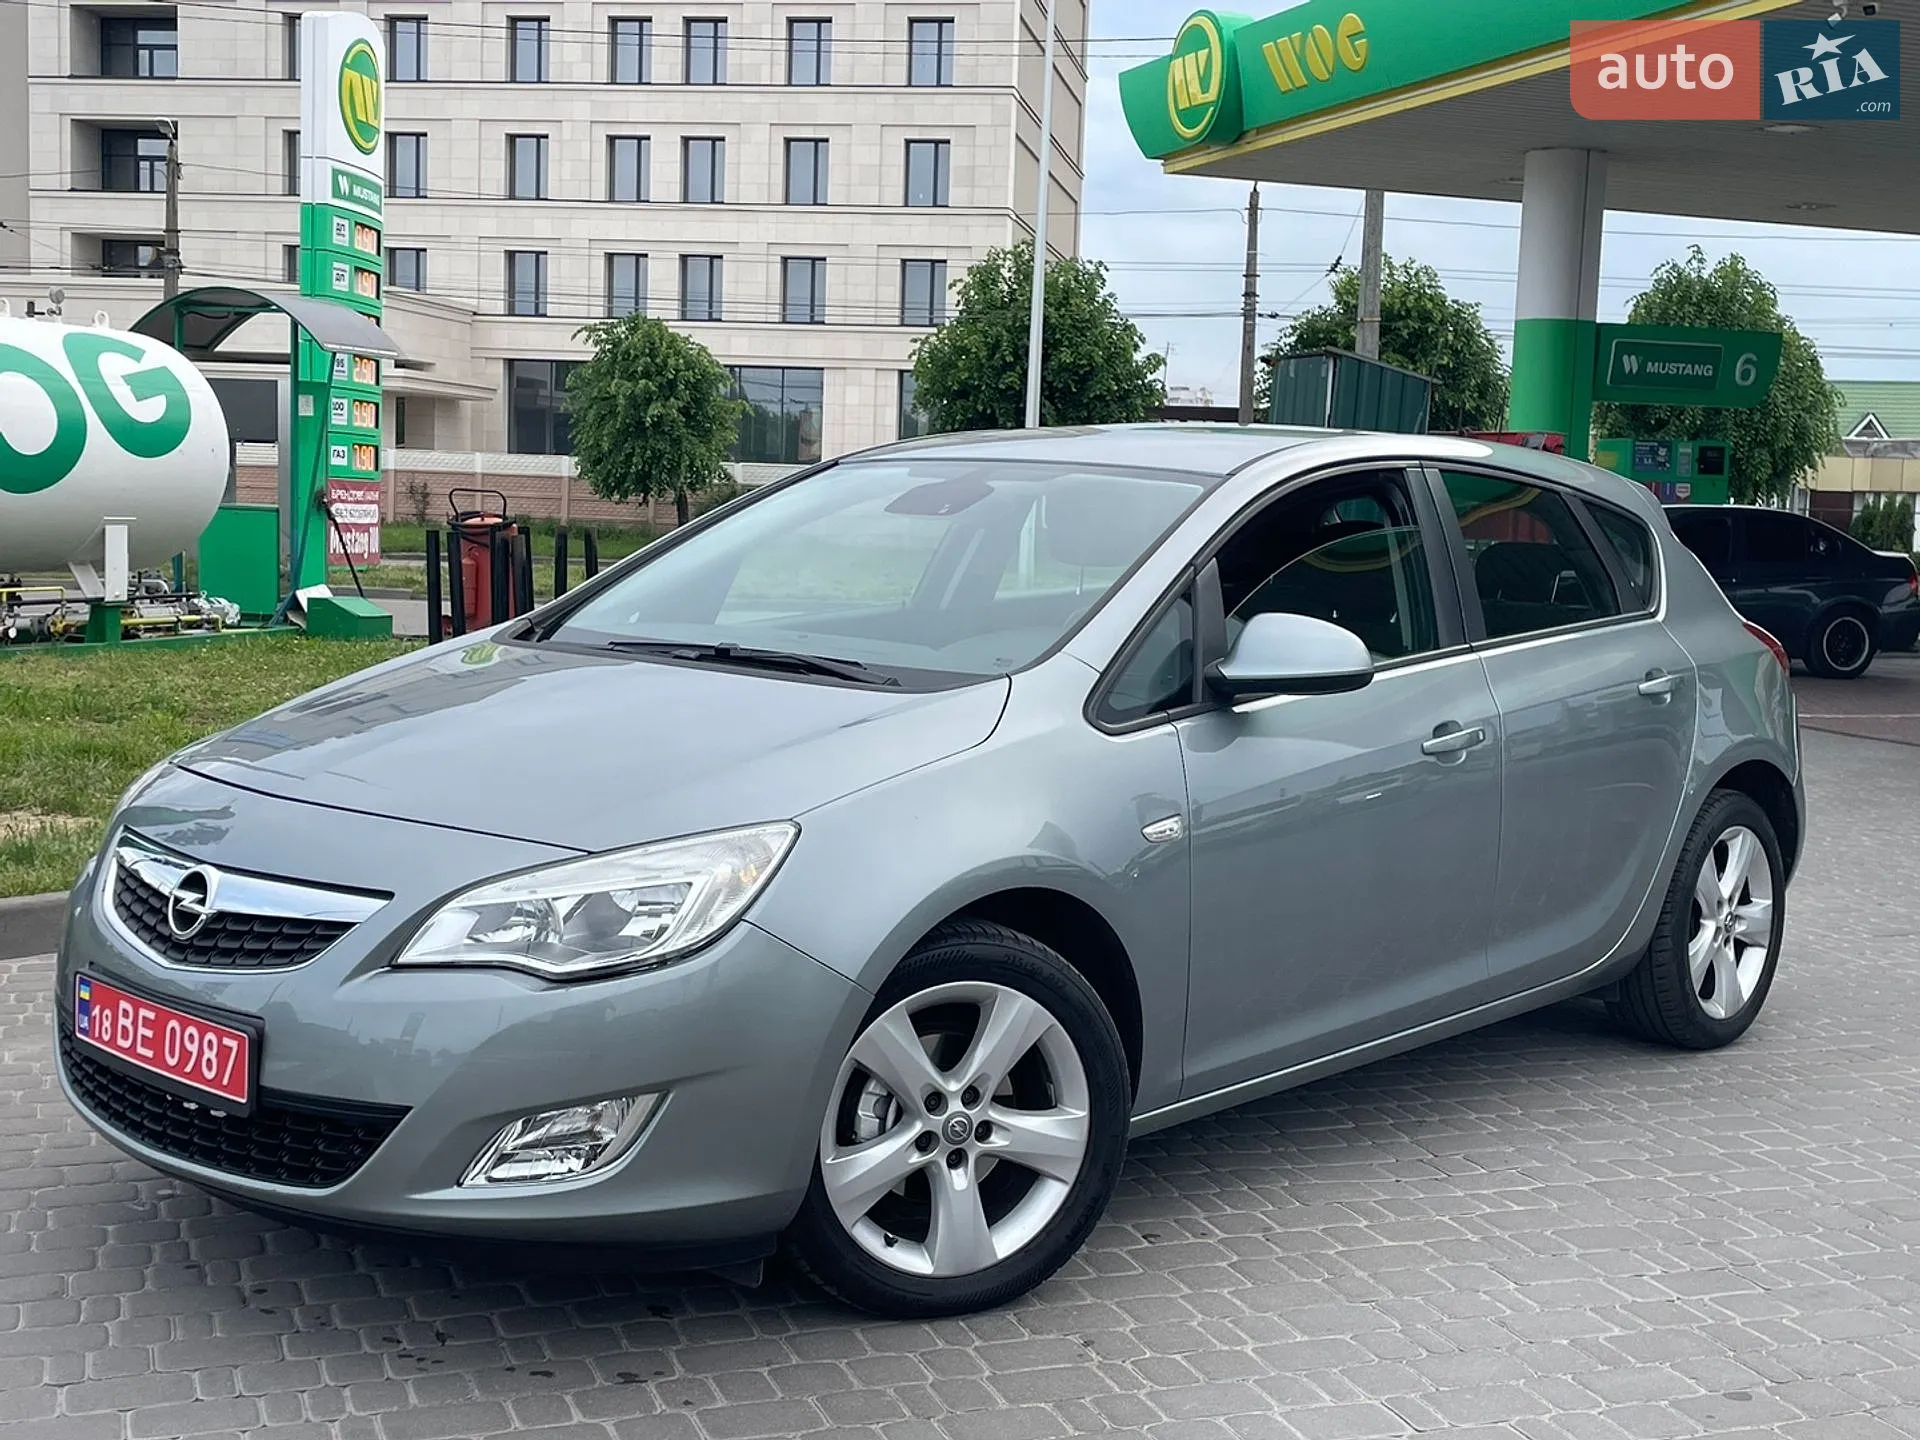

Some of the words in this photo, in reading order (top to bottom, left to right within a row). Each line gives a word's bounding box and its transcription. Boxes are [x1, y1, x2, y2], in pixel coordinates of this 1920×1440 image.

[1262, 13, 1367, 93] WOG
[1646, 360, 1714, 377] MUSTANG
[1735, 352, 1759, 387] 6
[332, 449, 346, 459] ГАЗ
[91, 1004, 112, 1042] 18
[116, 1000, 156, 1058] BE
[164, 1019, 239, 1086] 0987
